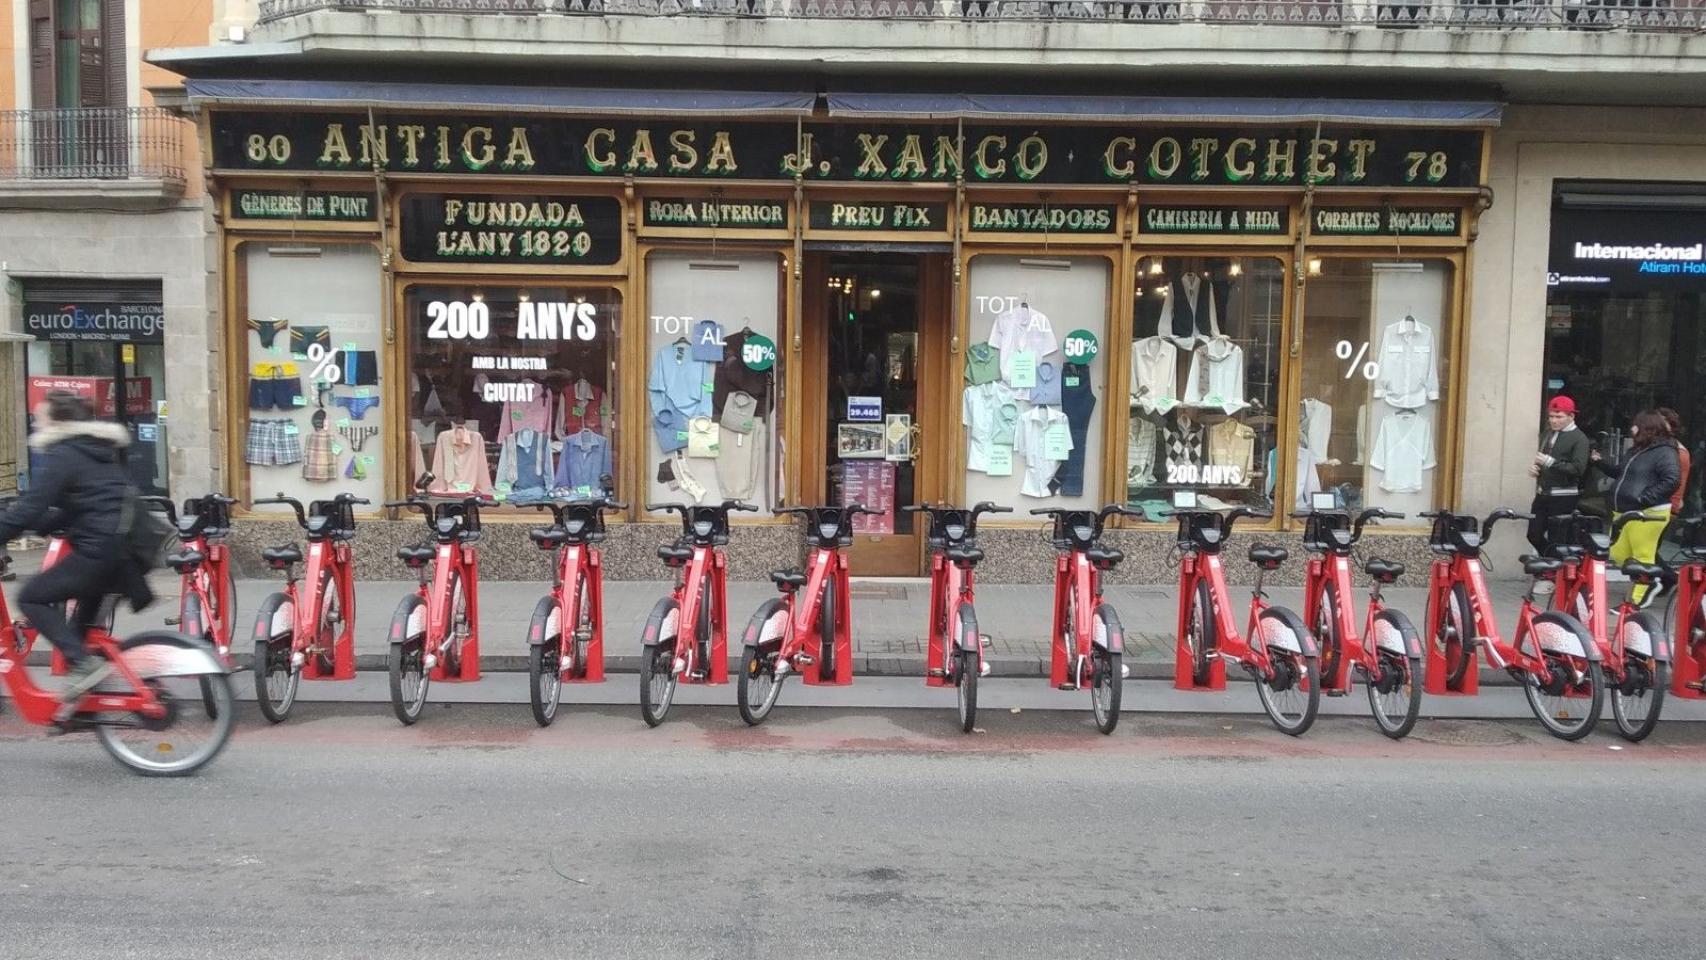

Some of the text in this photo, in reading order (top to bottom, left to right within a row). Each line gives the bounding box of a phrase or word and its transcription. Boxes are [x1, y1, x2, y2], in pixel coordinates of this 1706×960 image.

[247, 134, 291, 164] 80
[318, 122, 1376, 182] ANTIGA CASA J. XANCÓ COTCHET
[1406, 151, 1448, 181] 78
[240, 192, 368, 216] GÈNERES DE PUNT
[445, 199, 585, 227] FUNDADA
[649, 200, 783, 222] ROBA INTERIOR
[832, 203, 931, 227] PREU FIX
[973, 204, 1111, 229] BANYADORS
[1146, 208, 1281, 230] CAMISERIA A MIDA
[1317, 210, 1456, 232] CORBATES NOCADORS
[437, 230, 592, 257] L'ANY 1820
[1574, 242, 1703, 260] Internacional
[1639, 260, 1706, 273] Atiram Hot
[975, 295, 1019, 314] TOT
[28, 307, 164, 336] euroExchange
[426, 300, 597, 341] 200 ANYS
[650, 315, 694, 334] TOT
[1027, 313, 1053, 332] AL
[700, 327, 728, 346] AL
[1064, 337, 1098, 357] 50%
[306, 343, 341, 383] %
[472, 356, 548, 370] AMB LA NOSTRA
[742, 343, 775, 364] 50%
[1335, 340, 1380, 380] %
[483, 382, 535, 402] CIUTAT
[1166, 464, 1241, 485] 200 ANYS
